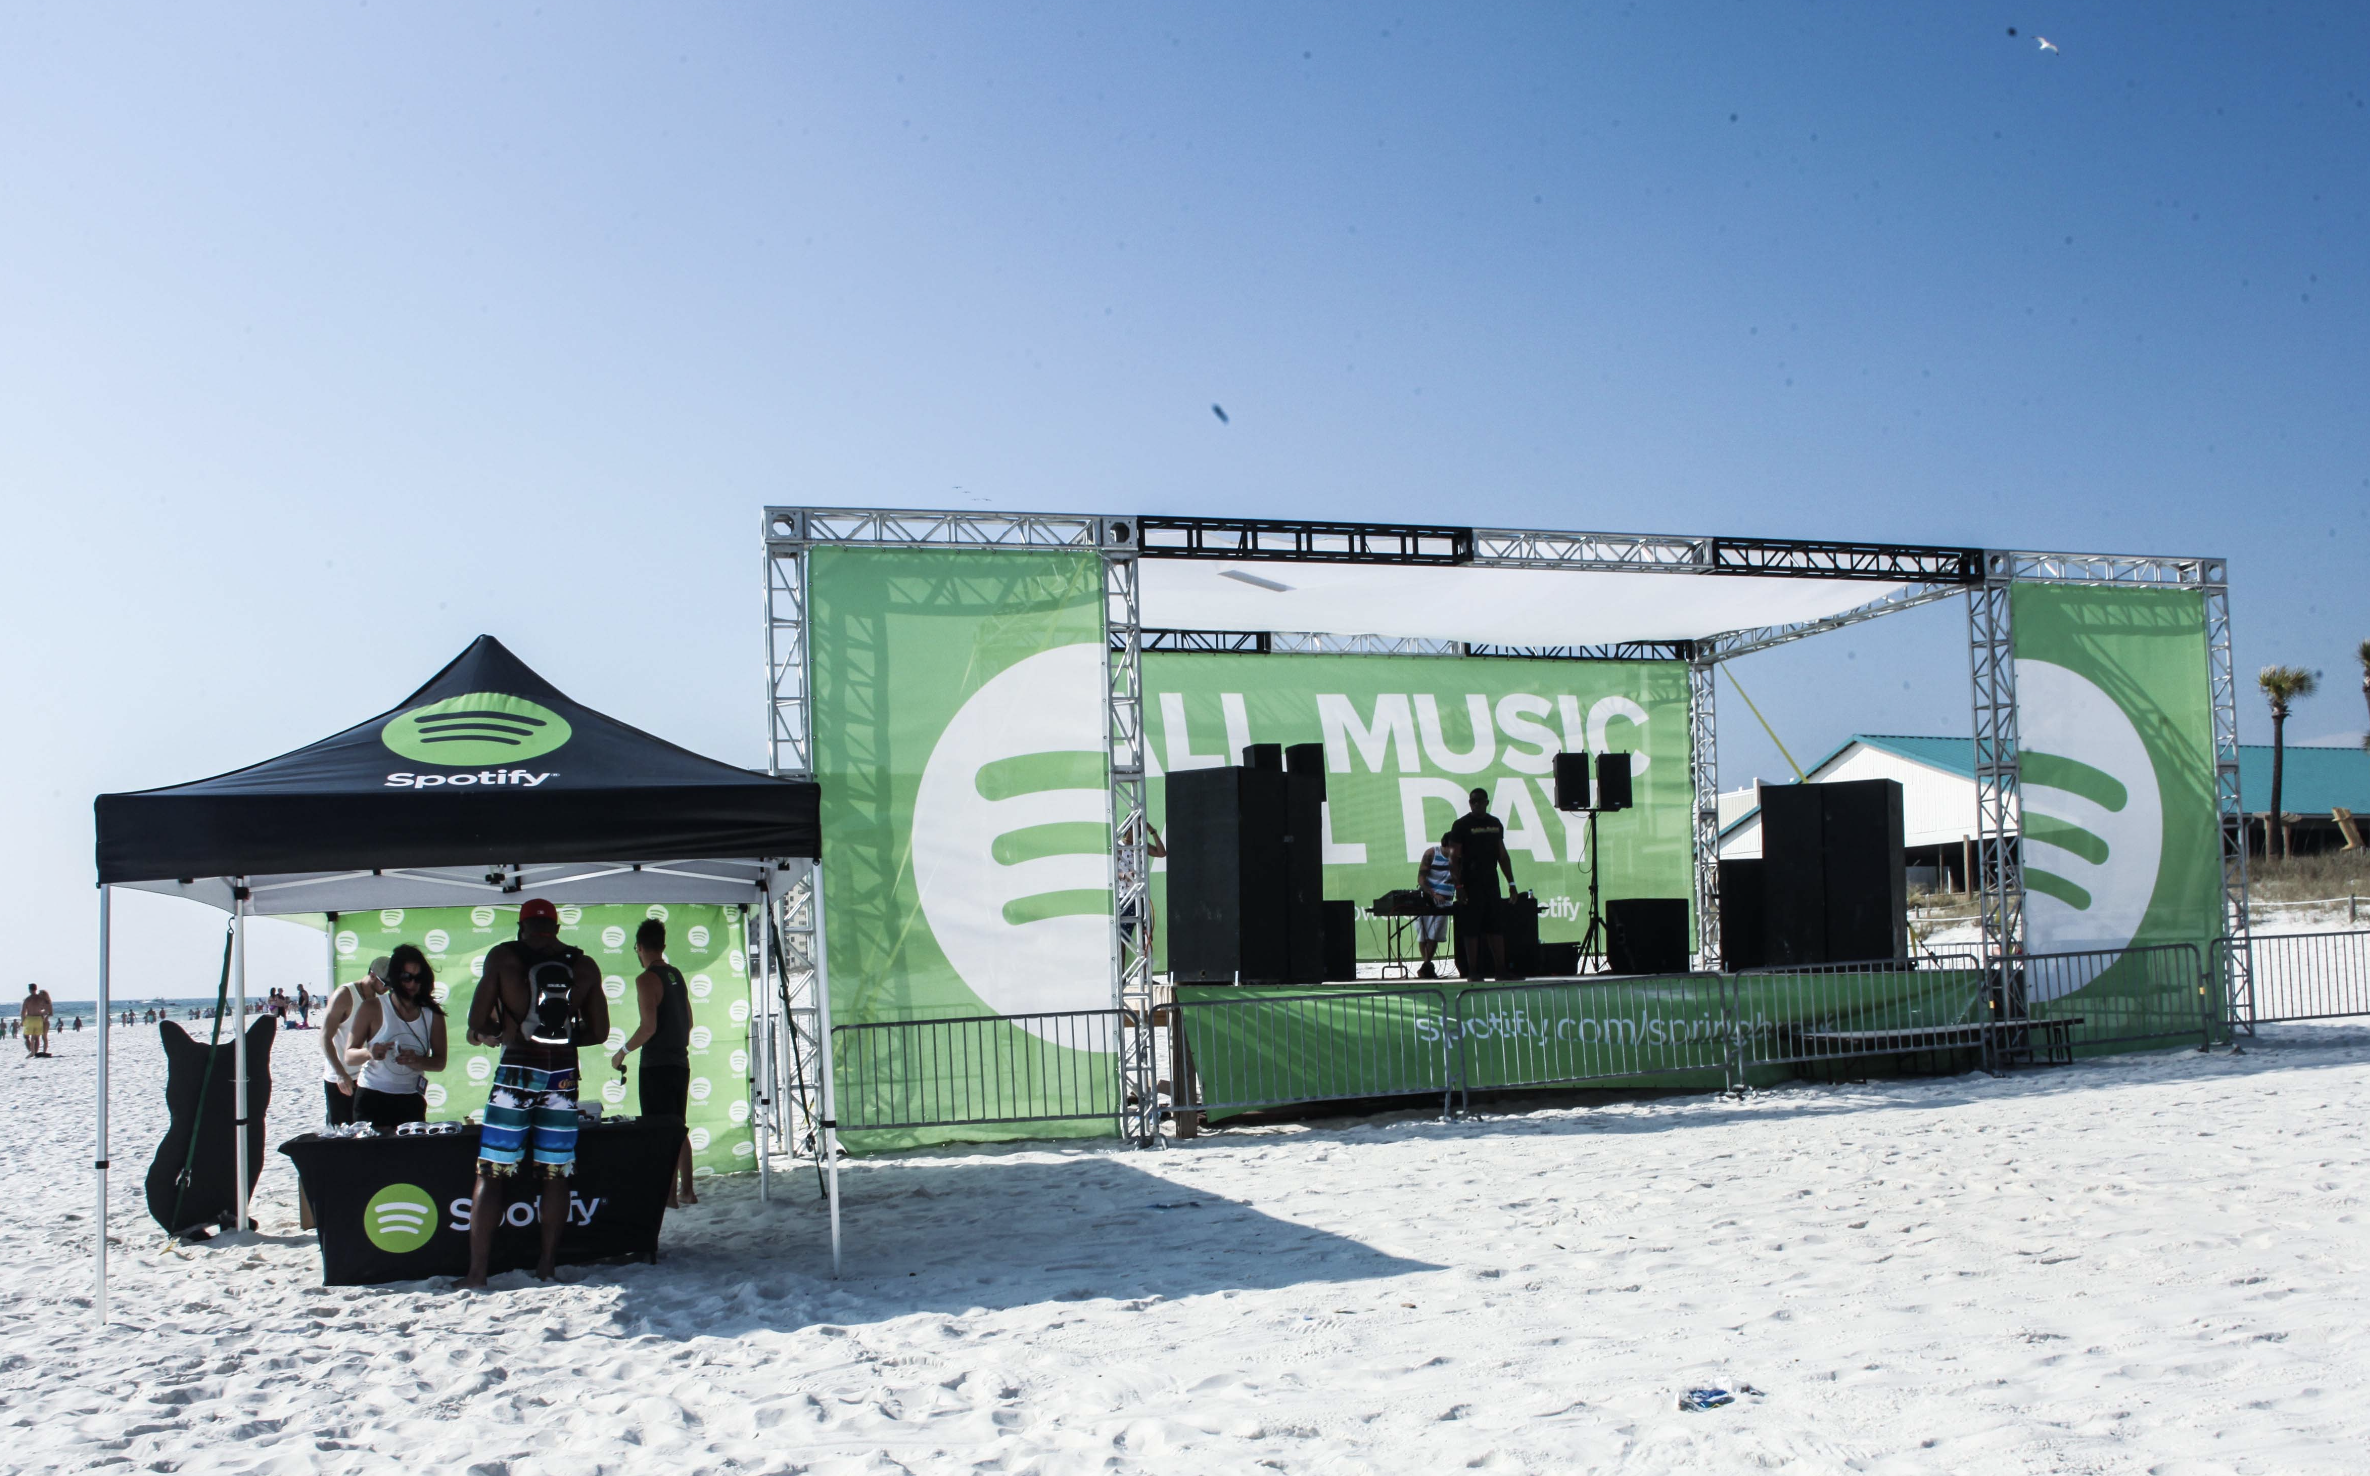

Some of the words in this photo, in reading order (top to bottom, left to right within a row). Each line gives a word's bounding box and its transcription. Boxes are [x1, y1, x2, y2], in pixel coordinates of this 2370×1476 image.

[1315, 693, 1651, 775] MUSIC
[384, 769, 551, 789] Spotify
[1398, 777, 1601, 863] DAY
[1537, 896, 1581, 922] otify
[449, 1190, 600, 1231] Sotfy
